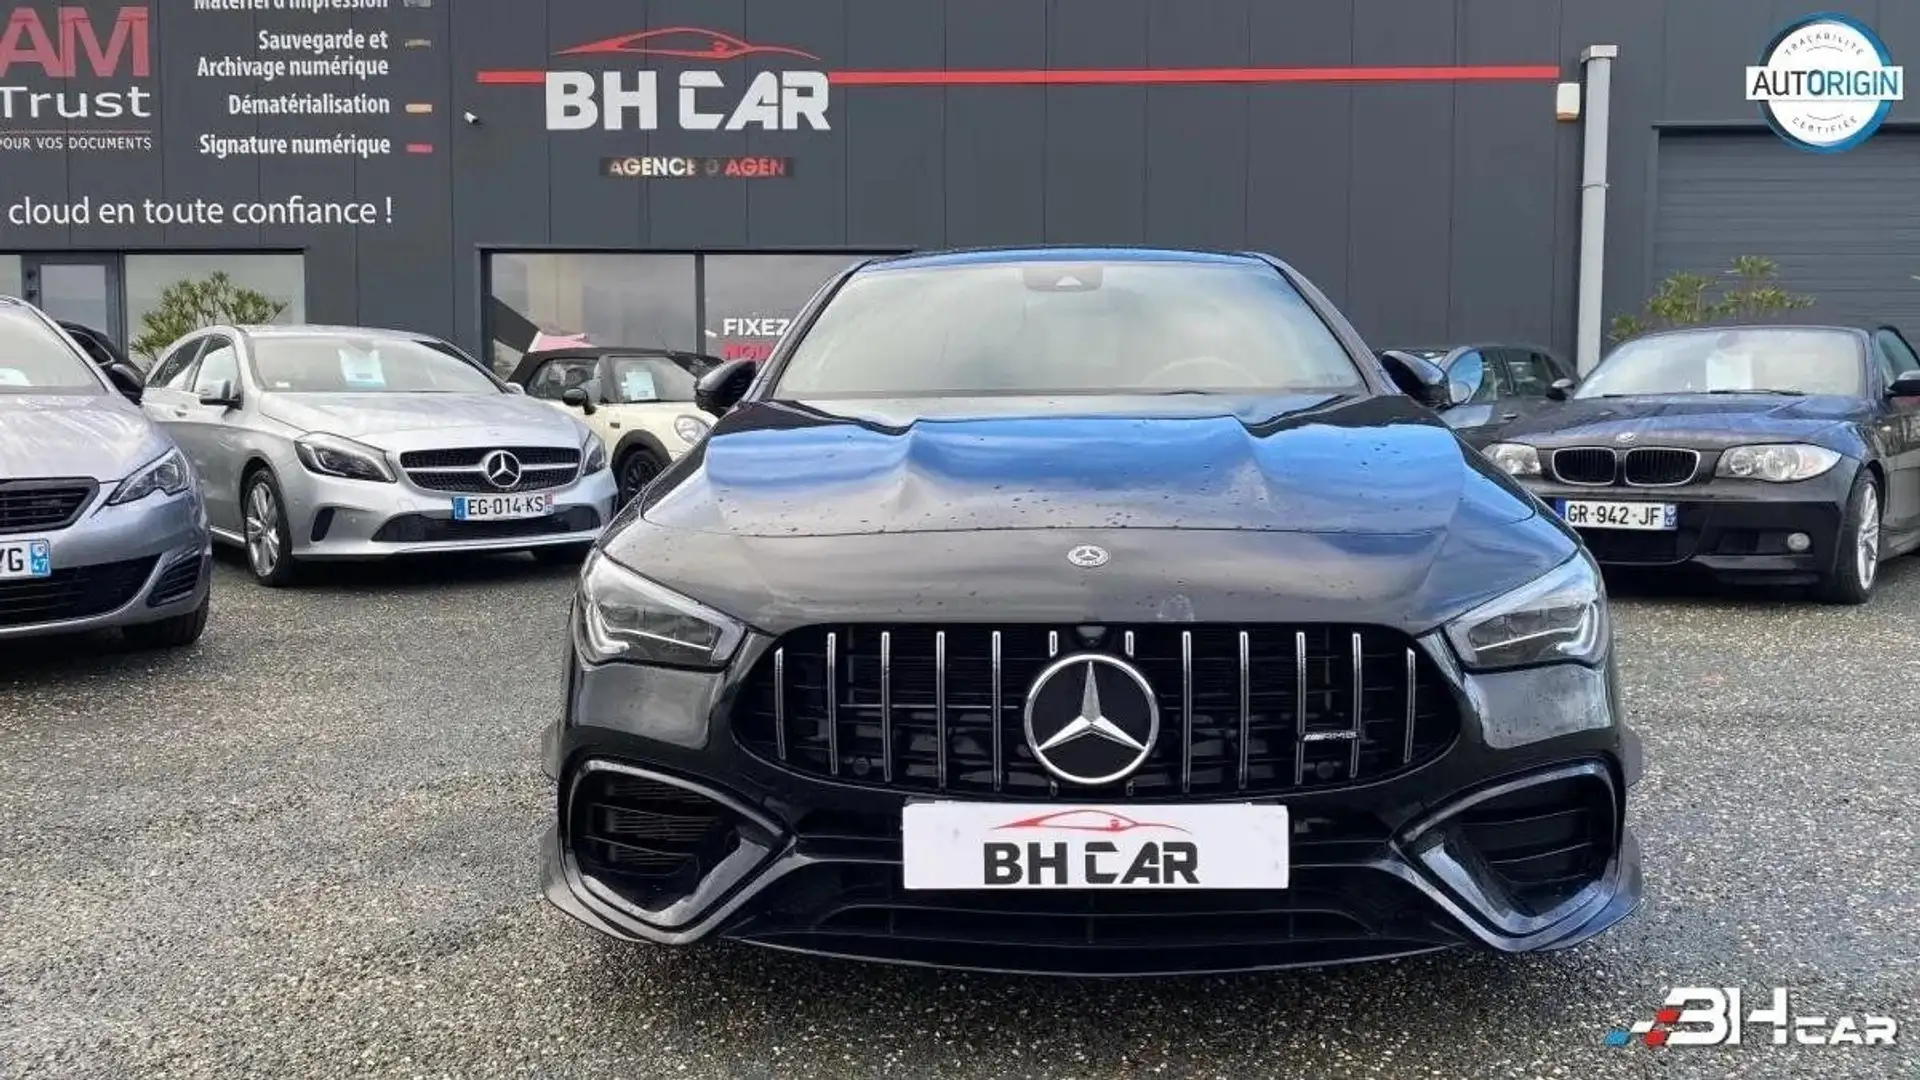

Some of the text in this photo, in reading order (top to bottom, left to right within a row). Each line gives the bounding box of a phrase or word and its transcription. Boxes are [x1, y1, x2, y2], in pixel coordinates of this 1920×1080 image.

[258, 29, 388, 54] Sauvegarde et
[197, 55, 388, 80] Archivage numérique
[228, 93, 390, 115] Dématérialisation
[546, 71, 831, 130] BH CAR
[36, 137, 64, 149] VOS
[68, 137, 152, 150] DOCUMENTS
[199, 133, 391, 159] Signature numérique
[8, 196, 90, 224] cloud
[99, 203, 135, 224] en
[143, 198, 224, 224] toute
[232, 195, 377, 224] confiance
[983, 841, 1200, 885] BH CAR
